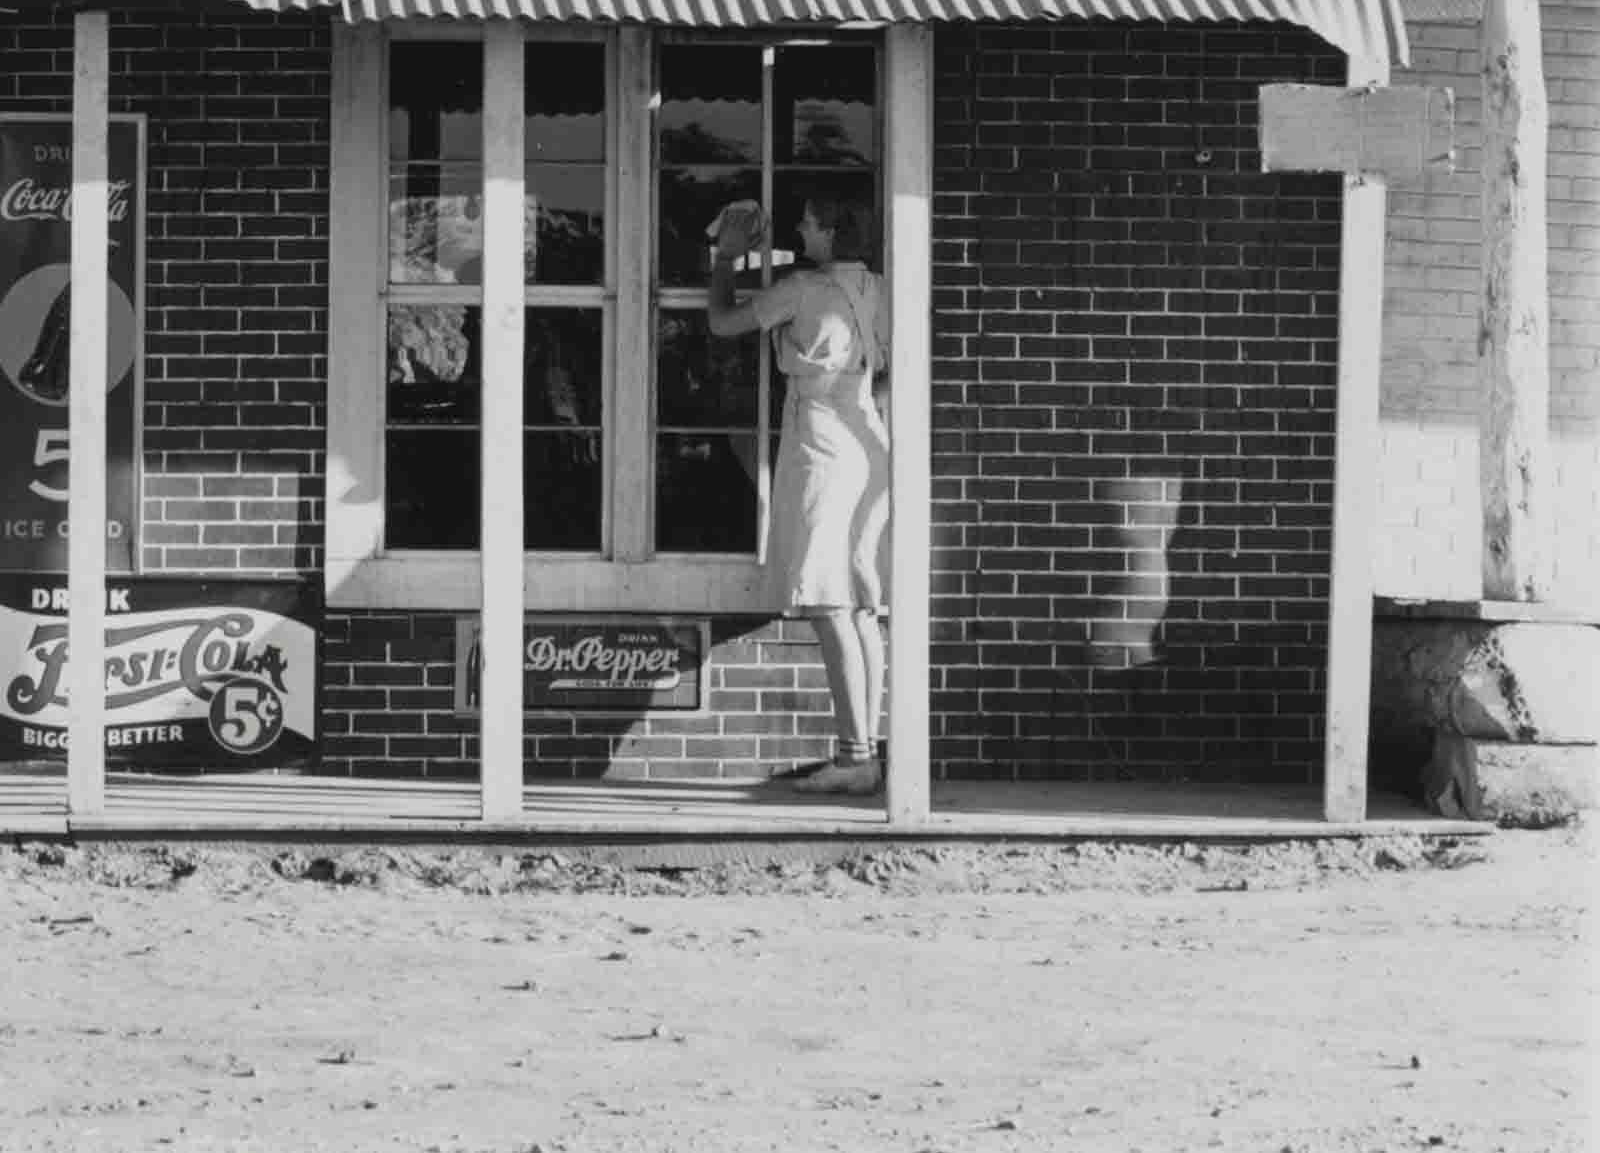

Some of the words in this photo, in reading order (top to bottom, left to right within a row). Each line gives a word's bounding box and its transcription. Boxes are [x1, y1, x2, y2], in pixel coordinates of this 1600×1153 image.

[4, 520, 44, 539] ICE
[57, 520, 123, 539] CD
[31, 587, 131, 611] DRK
